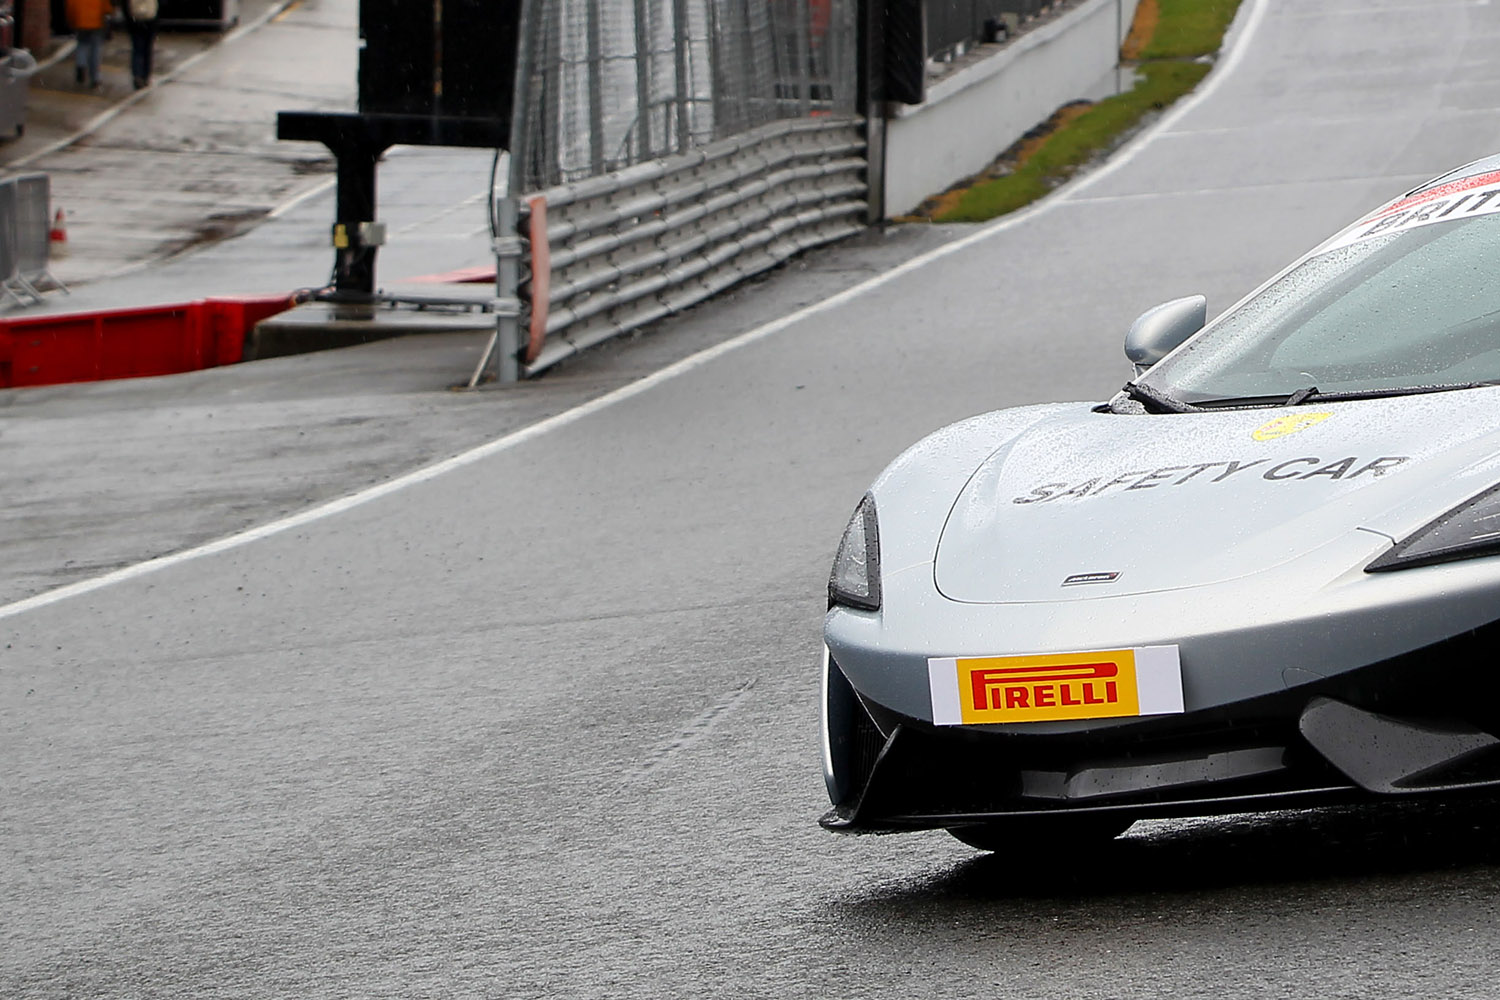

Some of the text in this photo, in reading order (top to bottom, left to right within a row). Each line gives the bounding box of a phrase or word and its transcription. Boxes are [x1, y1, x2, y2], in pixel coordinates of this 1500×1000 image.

[1012, 456, 1410, 504] SAFETY CAR
[970, 662, 1118, 710] PIRELLI
